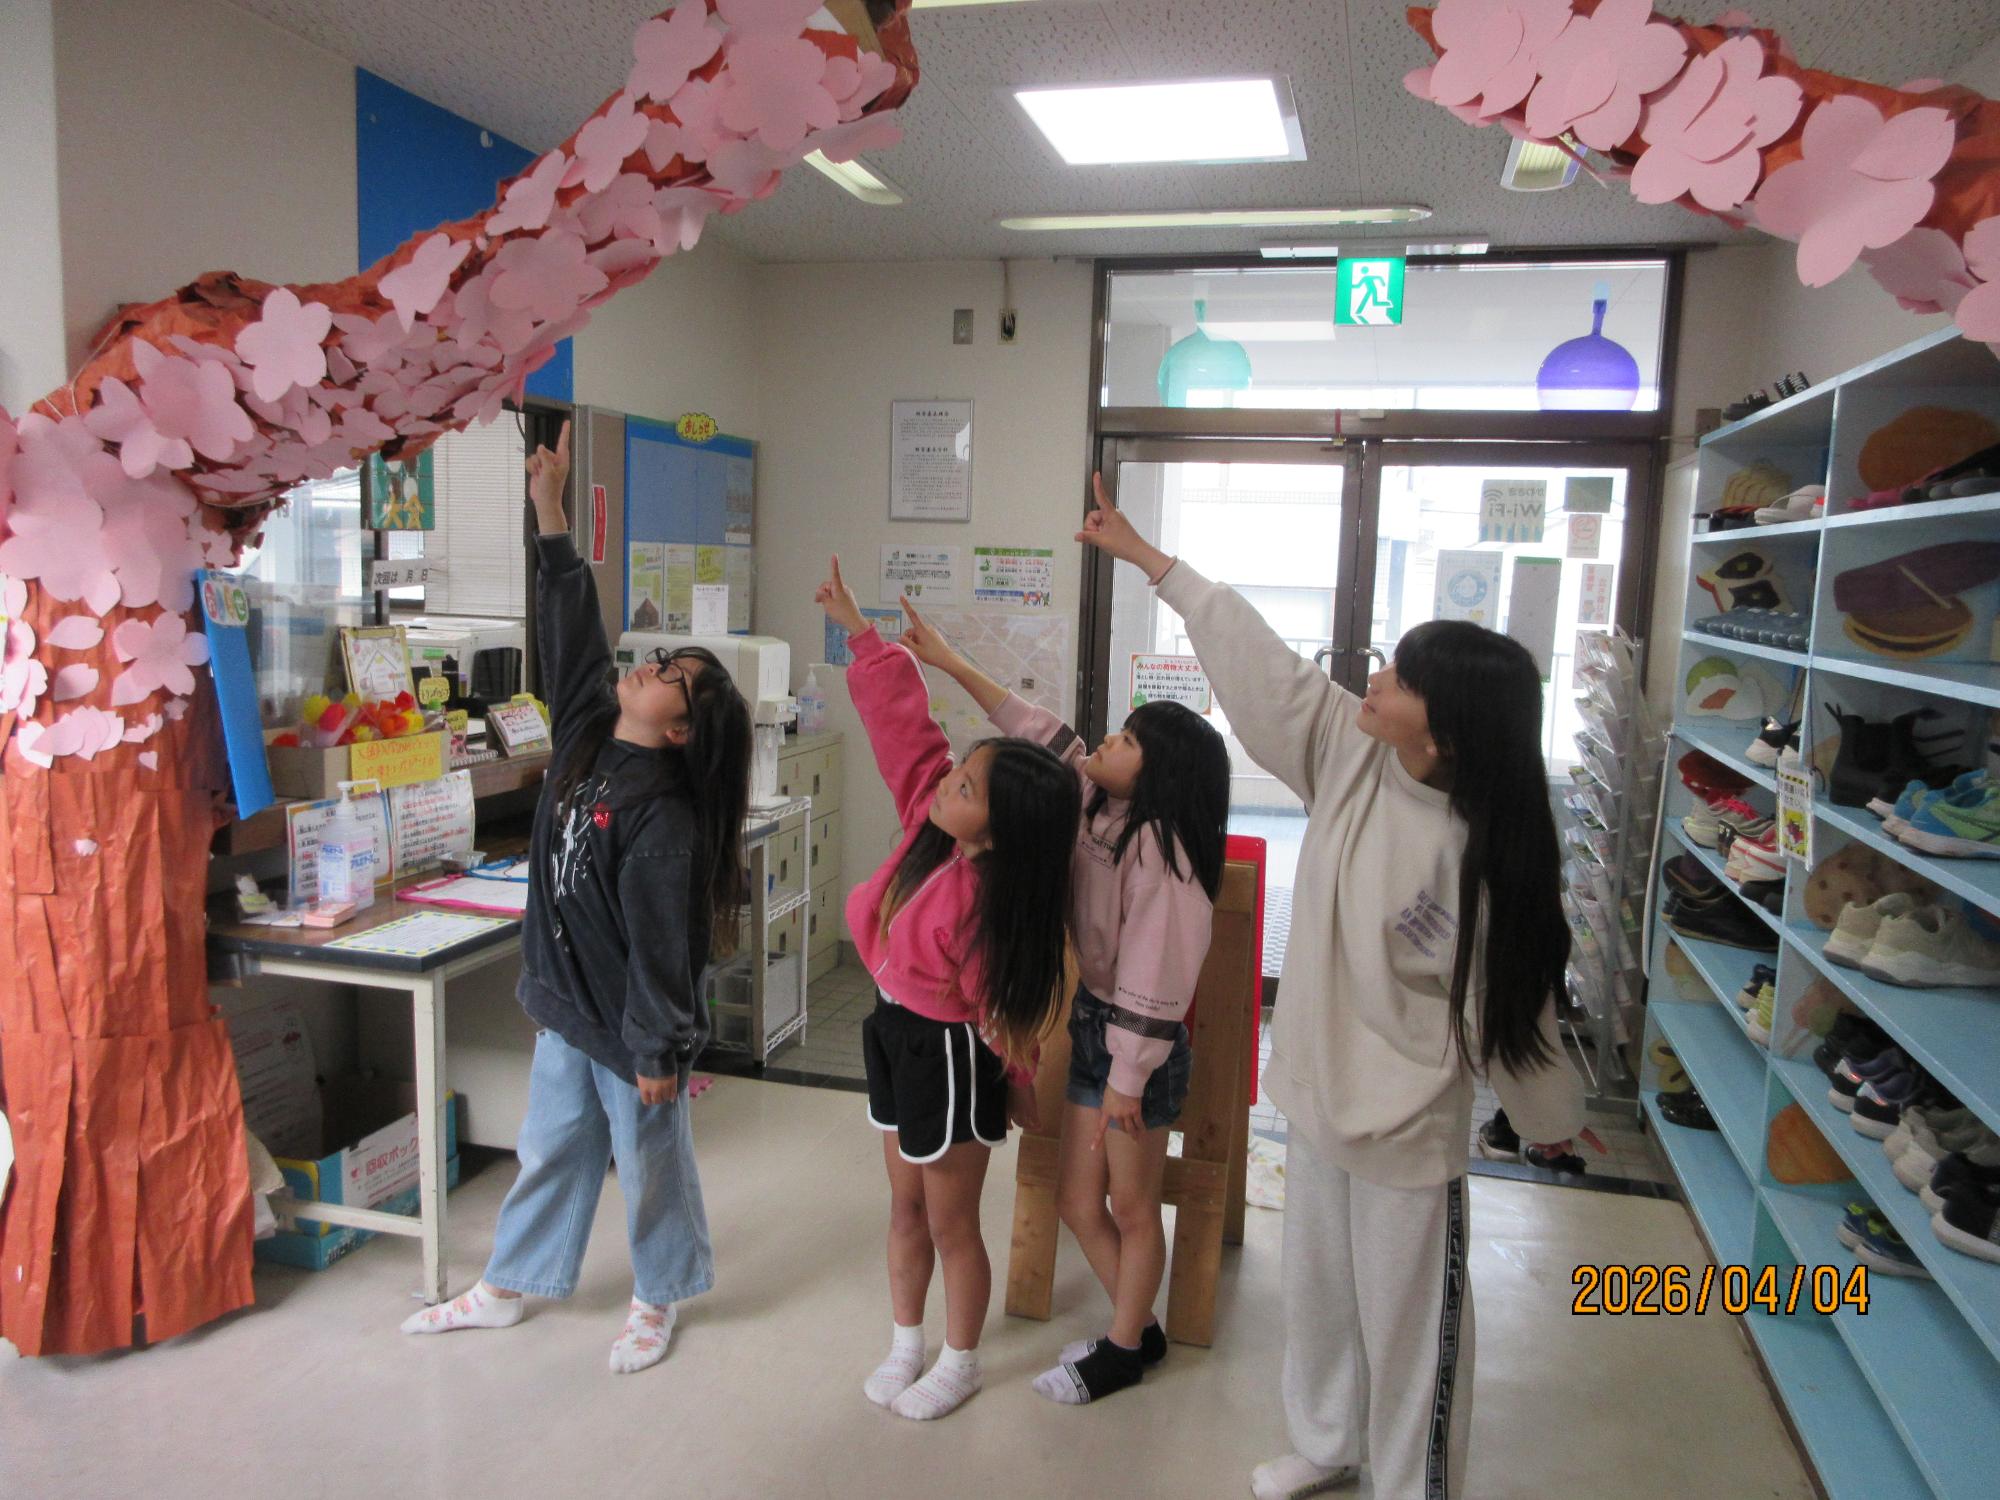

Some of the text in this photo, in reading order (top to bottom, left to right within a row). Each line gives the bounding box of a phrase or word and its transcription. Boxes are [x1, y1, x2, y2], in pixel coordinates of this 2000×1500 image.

[685, 419, 710, 435] おしらせ
[375, 571, 398, 585] 次回は
[366, 1136, 419, 1176] 回収ボック
